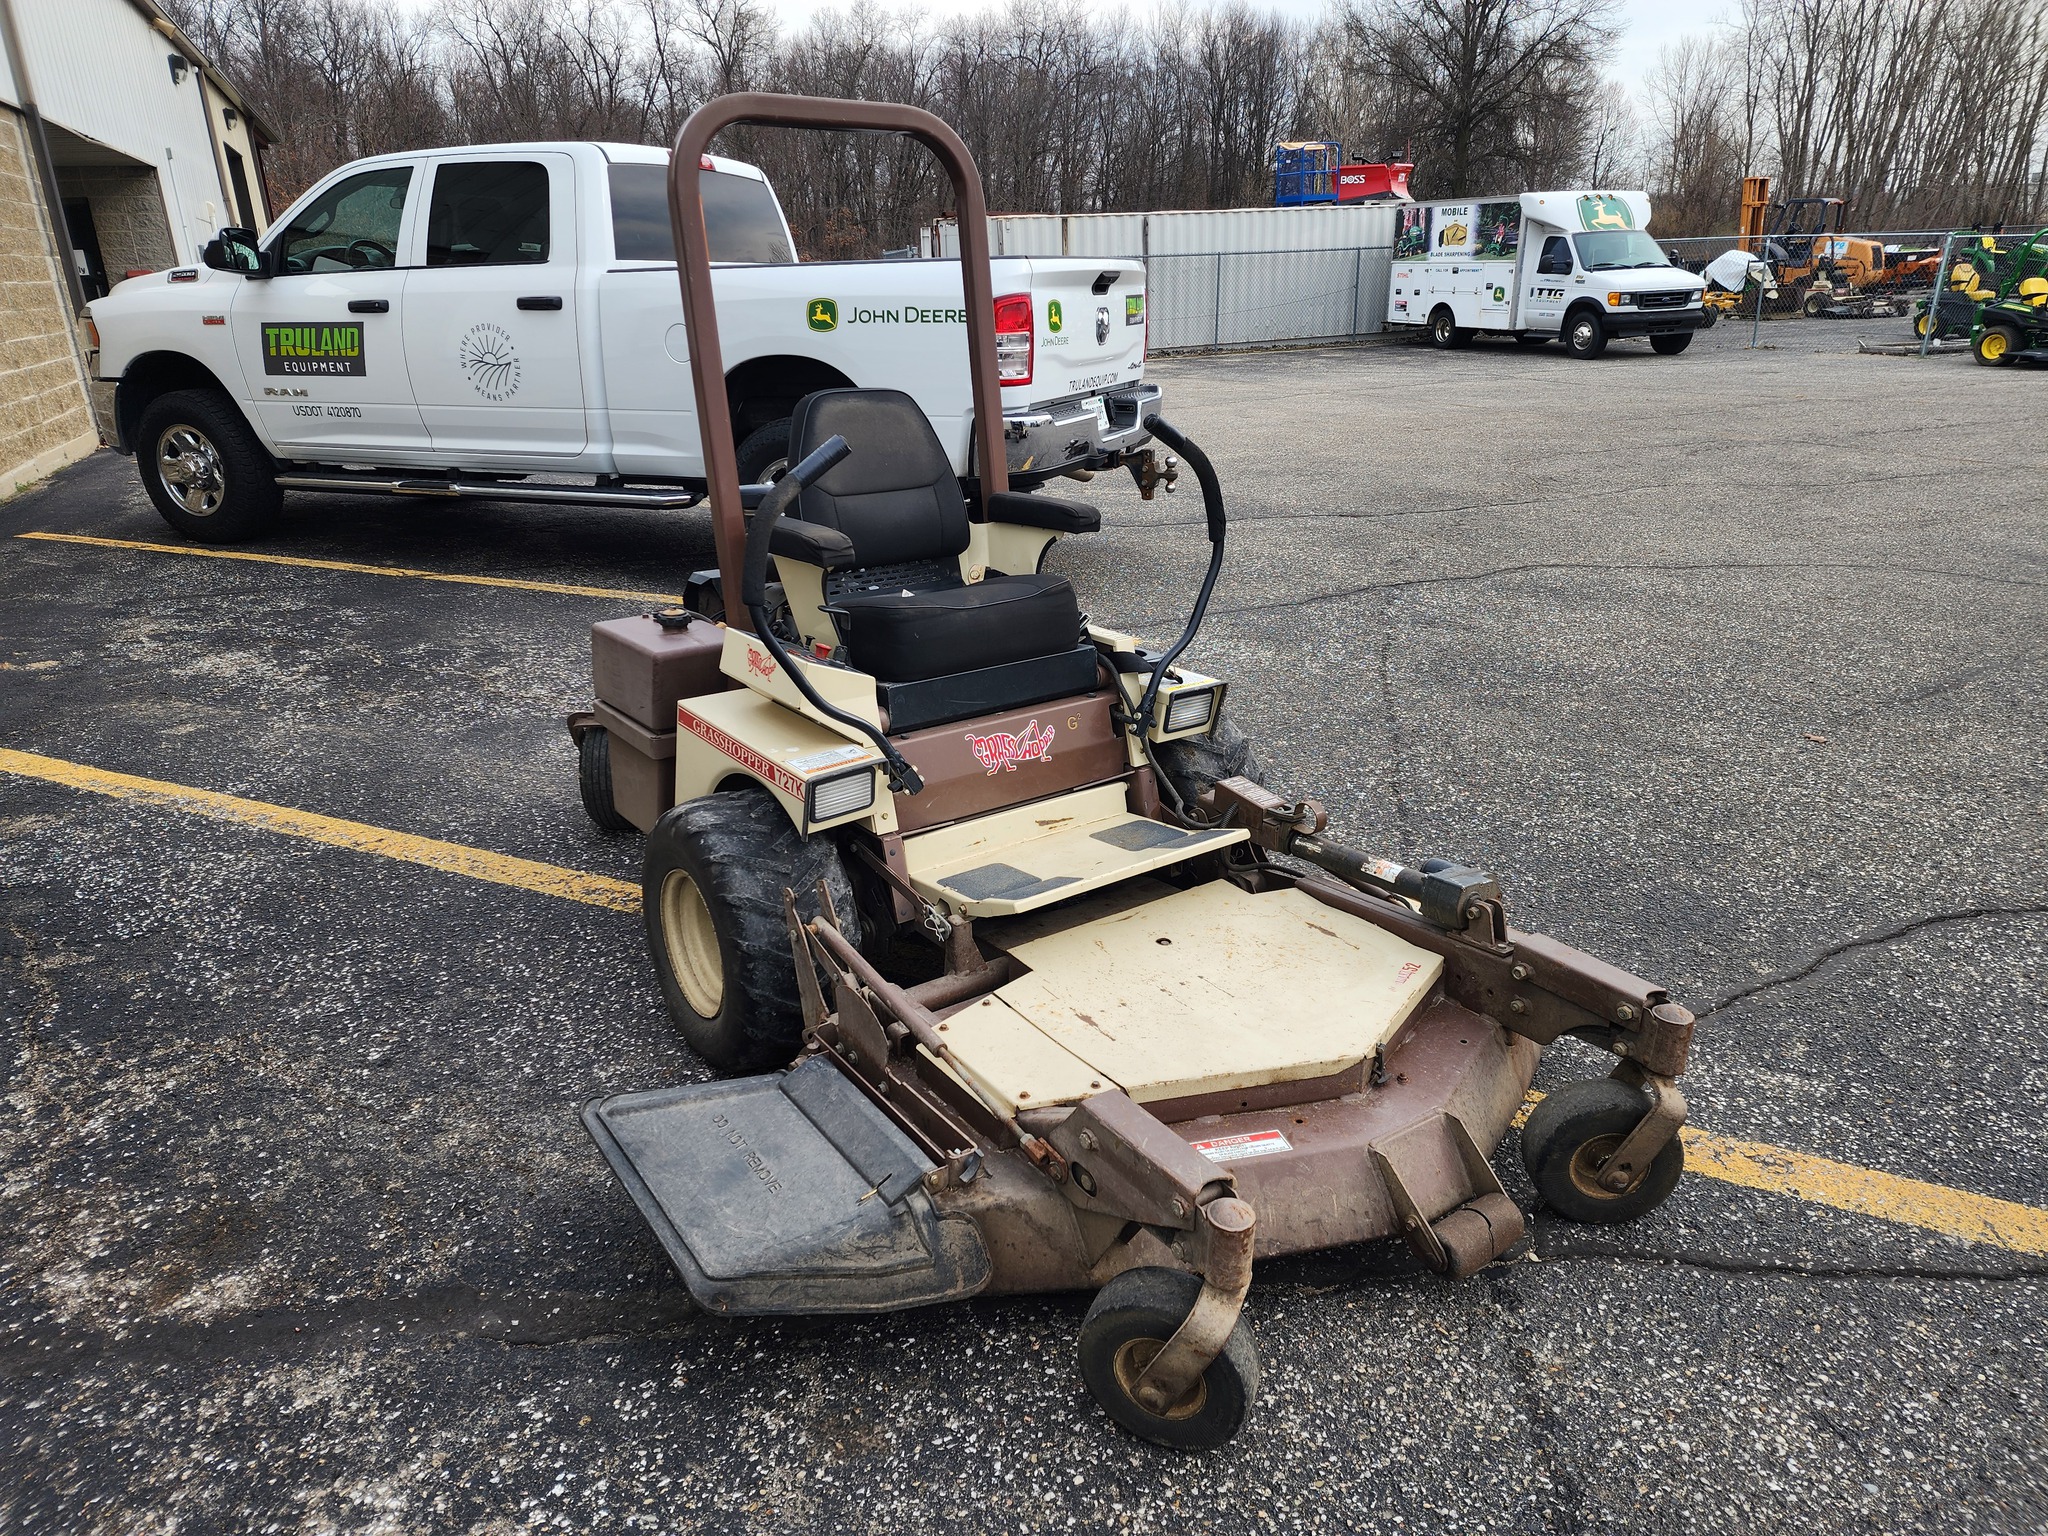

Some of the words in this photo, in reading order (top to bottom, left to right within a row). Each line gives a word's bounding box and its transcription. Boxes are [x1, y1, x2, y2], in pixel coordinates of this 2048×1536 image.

[1340, 175, 1366, 184] BOSS
[1441, 207, 1468, 216] MOBILE
[1536, 288, 1565, 297] TTG
[847, 307, 899, 324] JOHN
[470, 322, 511, 342] PROVIDER
[265, 327, 359, 357] TRULAND
[460, 334, 471, 369] WHERE
[284, 361, 351, 373] EQUIPMENT
[505, 357, 522, 399] PARTNER
[1068, 372, 1119, 392] TRULANDEQUIP.COM
[263, 387, 308, 397] RAM
[474, 385, 503, 402] MEANS
[292, 405, 323, 417] USDOT
[327, 406, 362, 418] 4120870
[692, 719, 771, 777] GRASSHOPPER
[775, 768, 805, 800] 727K
[1210, 1136, 1252, 1147] DANGER
[721, 1129, 748, 1150] NOT
[743, 1151, 783, 1194] REMOVE
